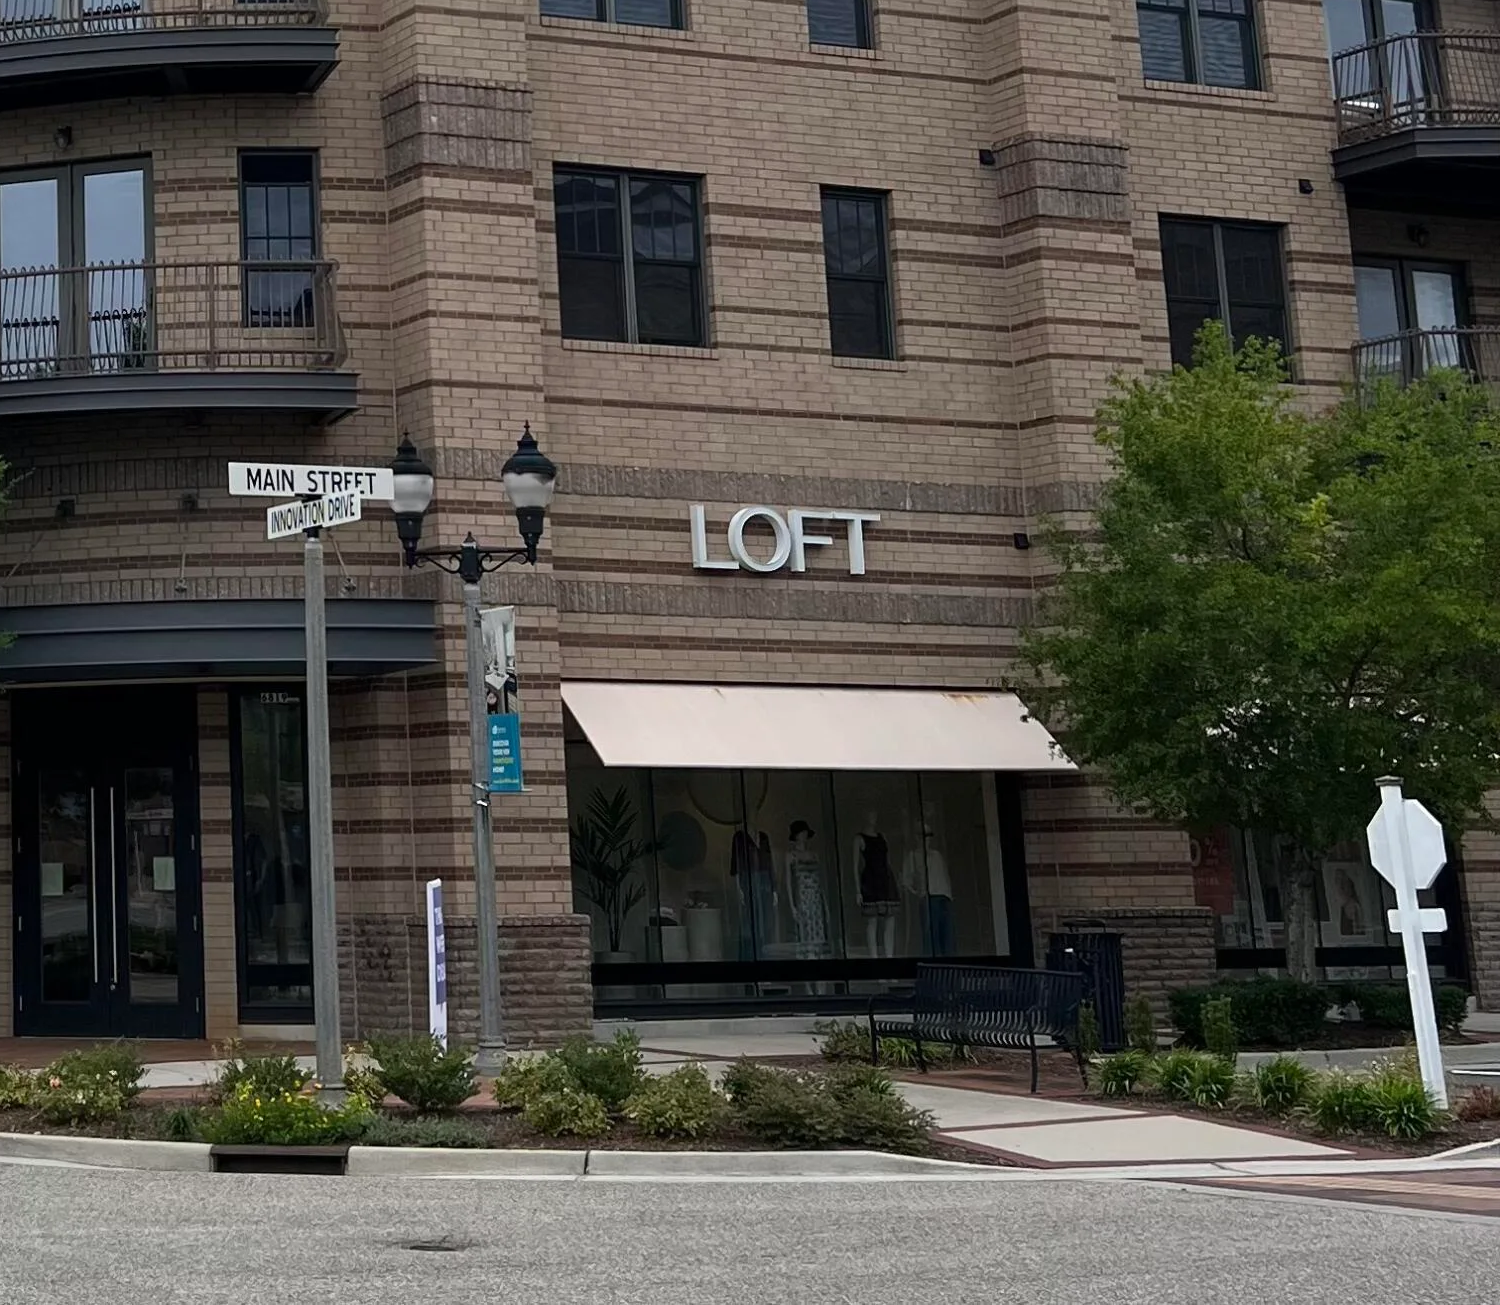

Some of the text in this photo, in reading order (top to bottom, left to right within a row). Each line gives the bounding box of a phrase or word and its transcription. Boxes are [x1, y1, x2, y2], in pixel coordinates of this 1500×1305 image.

[246, 468, 377, 495] MAIN STREET
[271, 494, 355, 534] INNOVATION DRIVE
[689, 503, 881, 575] LOFT
